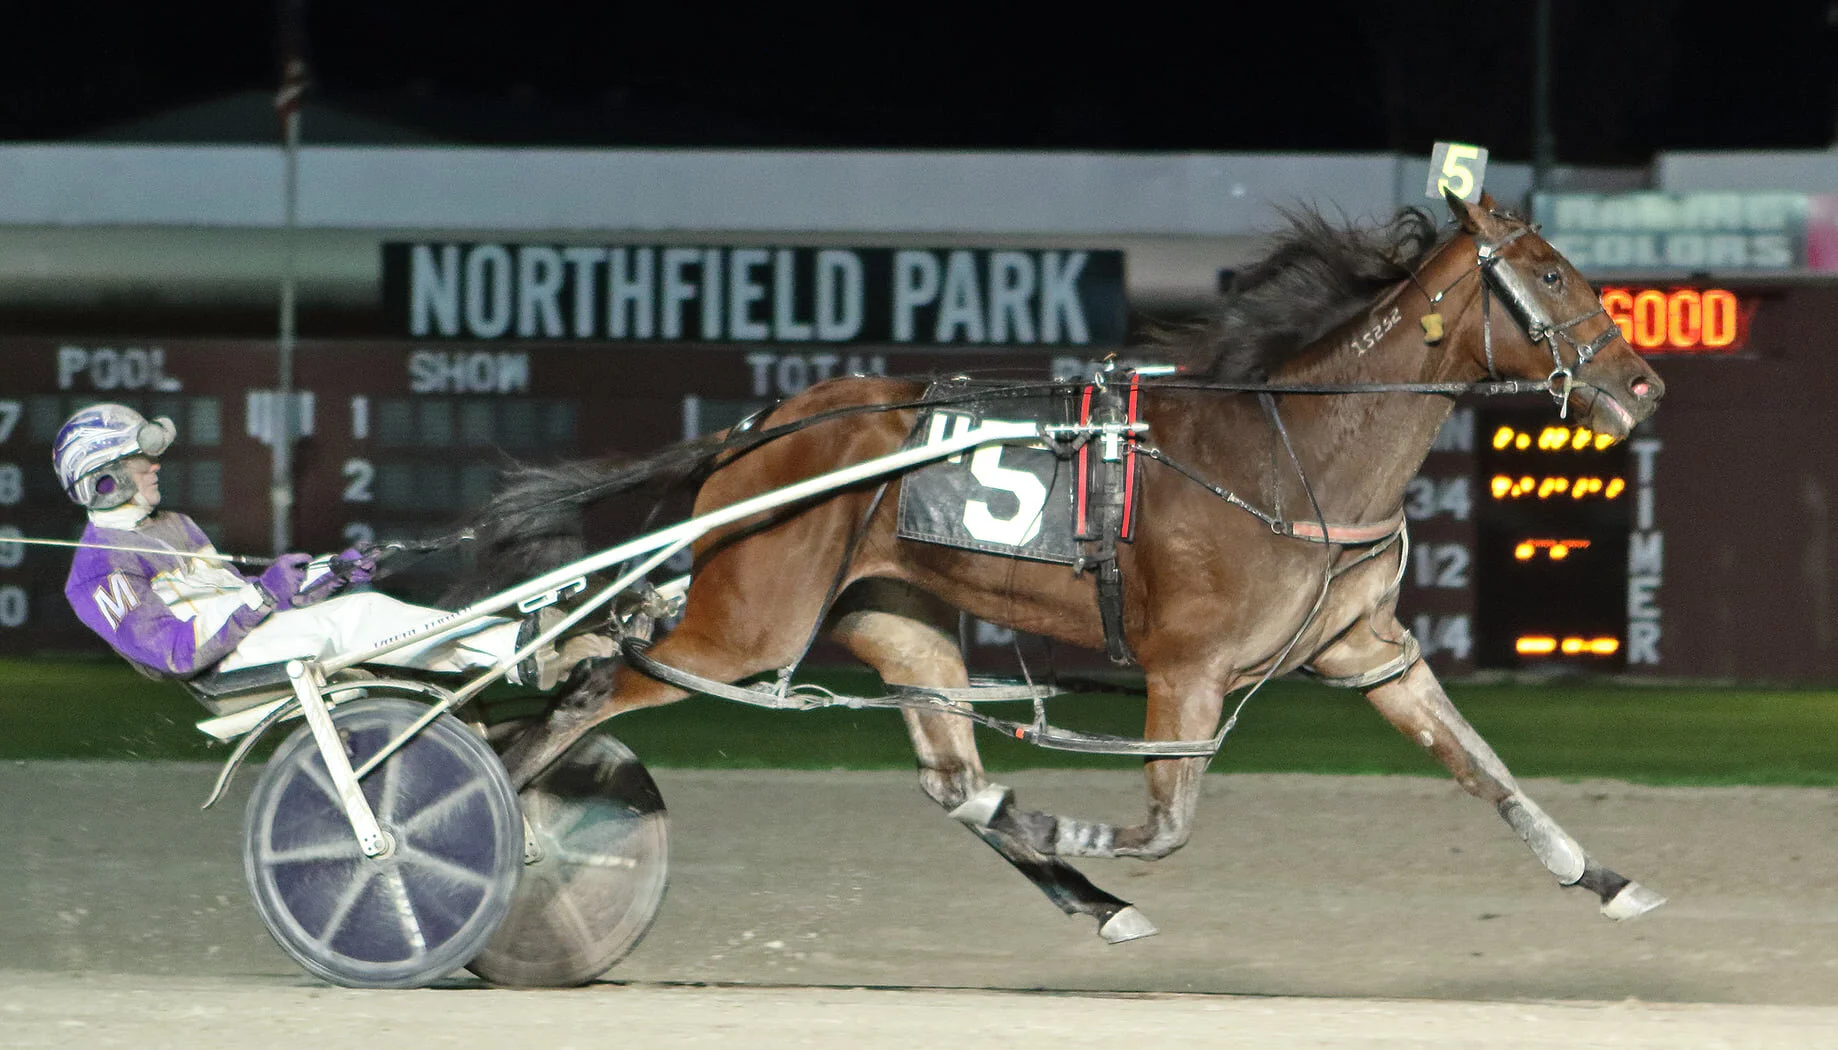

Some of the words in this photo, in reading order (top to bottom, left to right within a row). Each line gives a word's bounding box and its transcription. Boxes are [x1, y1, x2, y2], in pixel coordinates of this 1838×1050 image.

[1438, 145, 1478, 200] 5
[410, 245, 865, 342] NORTHFIELD
[892, 250, 1090, 345] PARK
[1602, 290, 1737, 347] GOOD
[409, 353, 530, 392] SHOW
[343, 459, 374, 501] 2
[963, 443, 1047, 546] 5
[1628, 441, 1664, 663] TIMER
[94, 570, 141, 632] M
